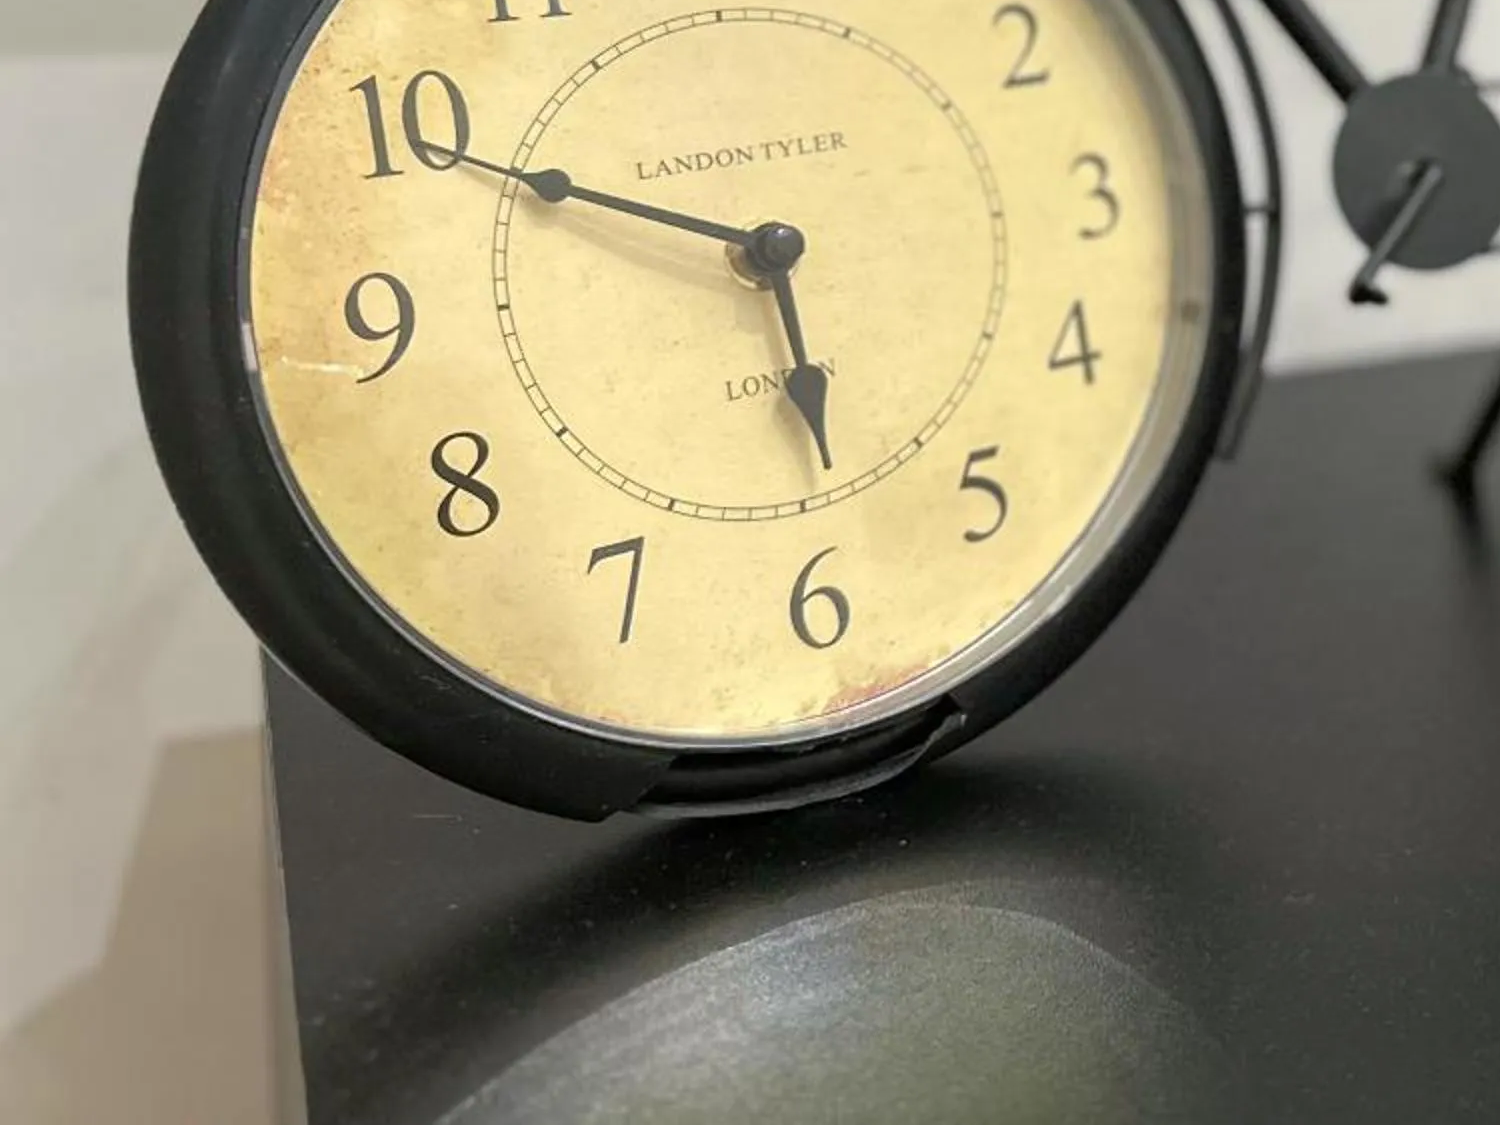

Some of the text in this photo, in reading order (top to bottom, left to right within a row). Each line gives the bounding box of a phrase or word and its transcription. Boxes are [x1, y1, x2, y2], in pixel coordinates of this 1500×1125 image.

[992, 2, 1051, 89] 2
[349, 70, 471, 179] 10
[636, 131, 848, 181] LANDON TYLER
[1070, 152, 1120, 241] 3
[344, 272, 416, 384] 9
[1047, 299, 1102, 385] 4
[725, 358, 837, 402] LONN
[430, 431, 500, 537] 8
[958, 444, 1009, 543] 5
[587, 535, 645, 644] 7
[789, 546, 851, 649] 6
